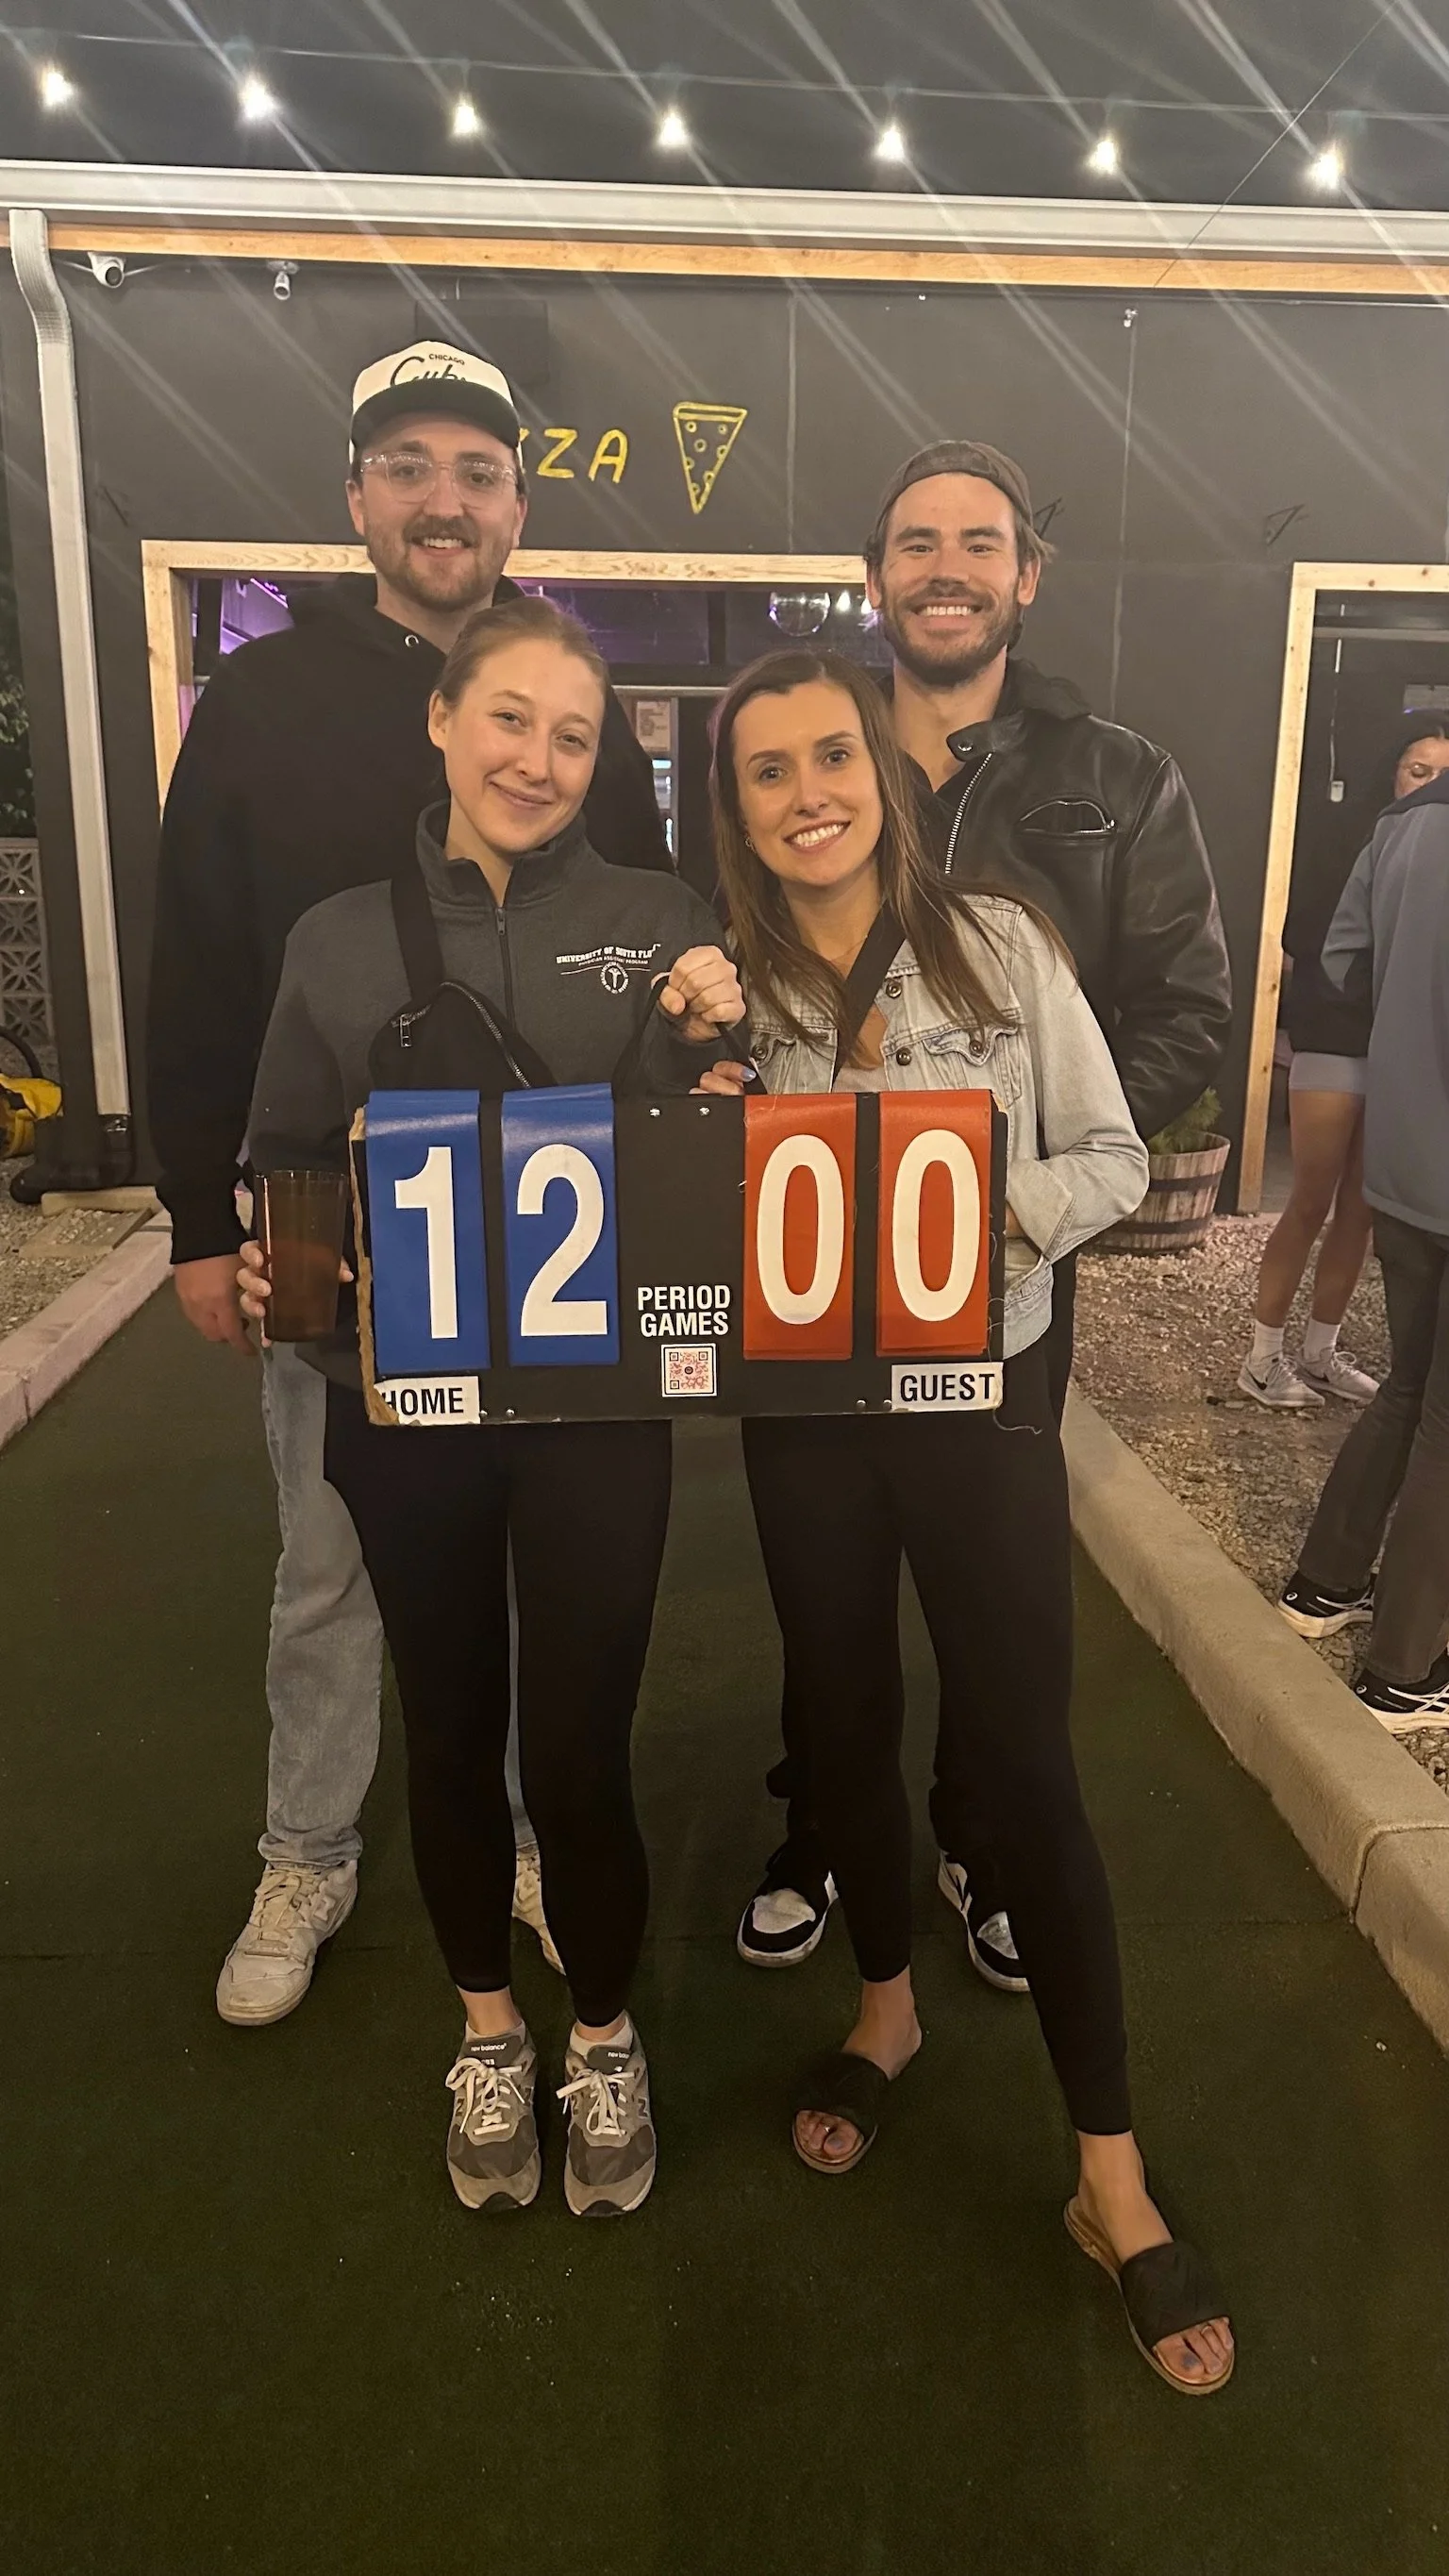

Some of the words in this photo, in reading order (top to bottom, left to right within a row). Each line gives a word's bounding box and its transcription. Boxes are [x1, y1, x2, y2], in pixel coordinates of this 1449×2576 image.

[428, 353, 465, 365] CHICAGO
[519, 427, 628, 483] ZA
[556, 947, 603, 963] UNIVERSITY
[603, 945, 614, 955] OF
[615, 946, 637, 959] SOUTH
[638, 947, 658, 959] FLO
[638, 1284, 731, 1311] PERIOD
[640, 1311, 729, 1338] GAMES
[900, 1373, 995, 1402] GUEST
